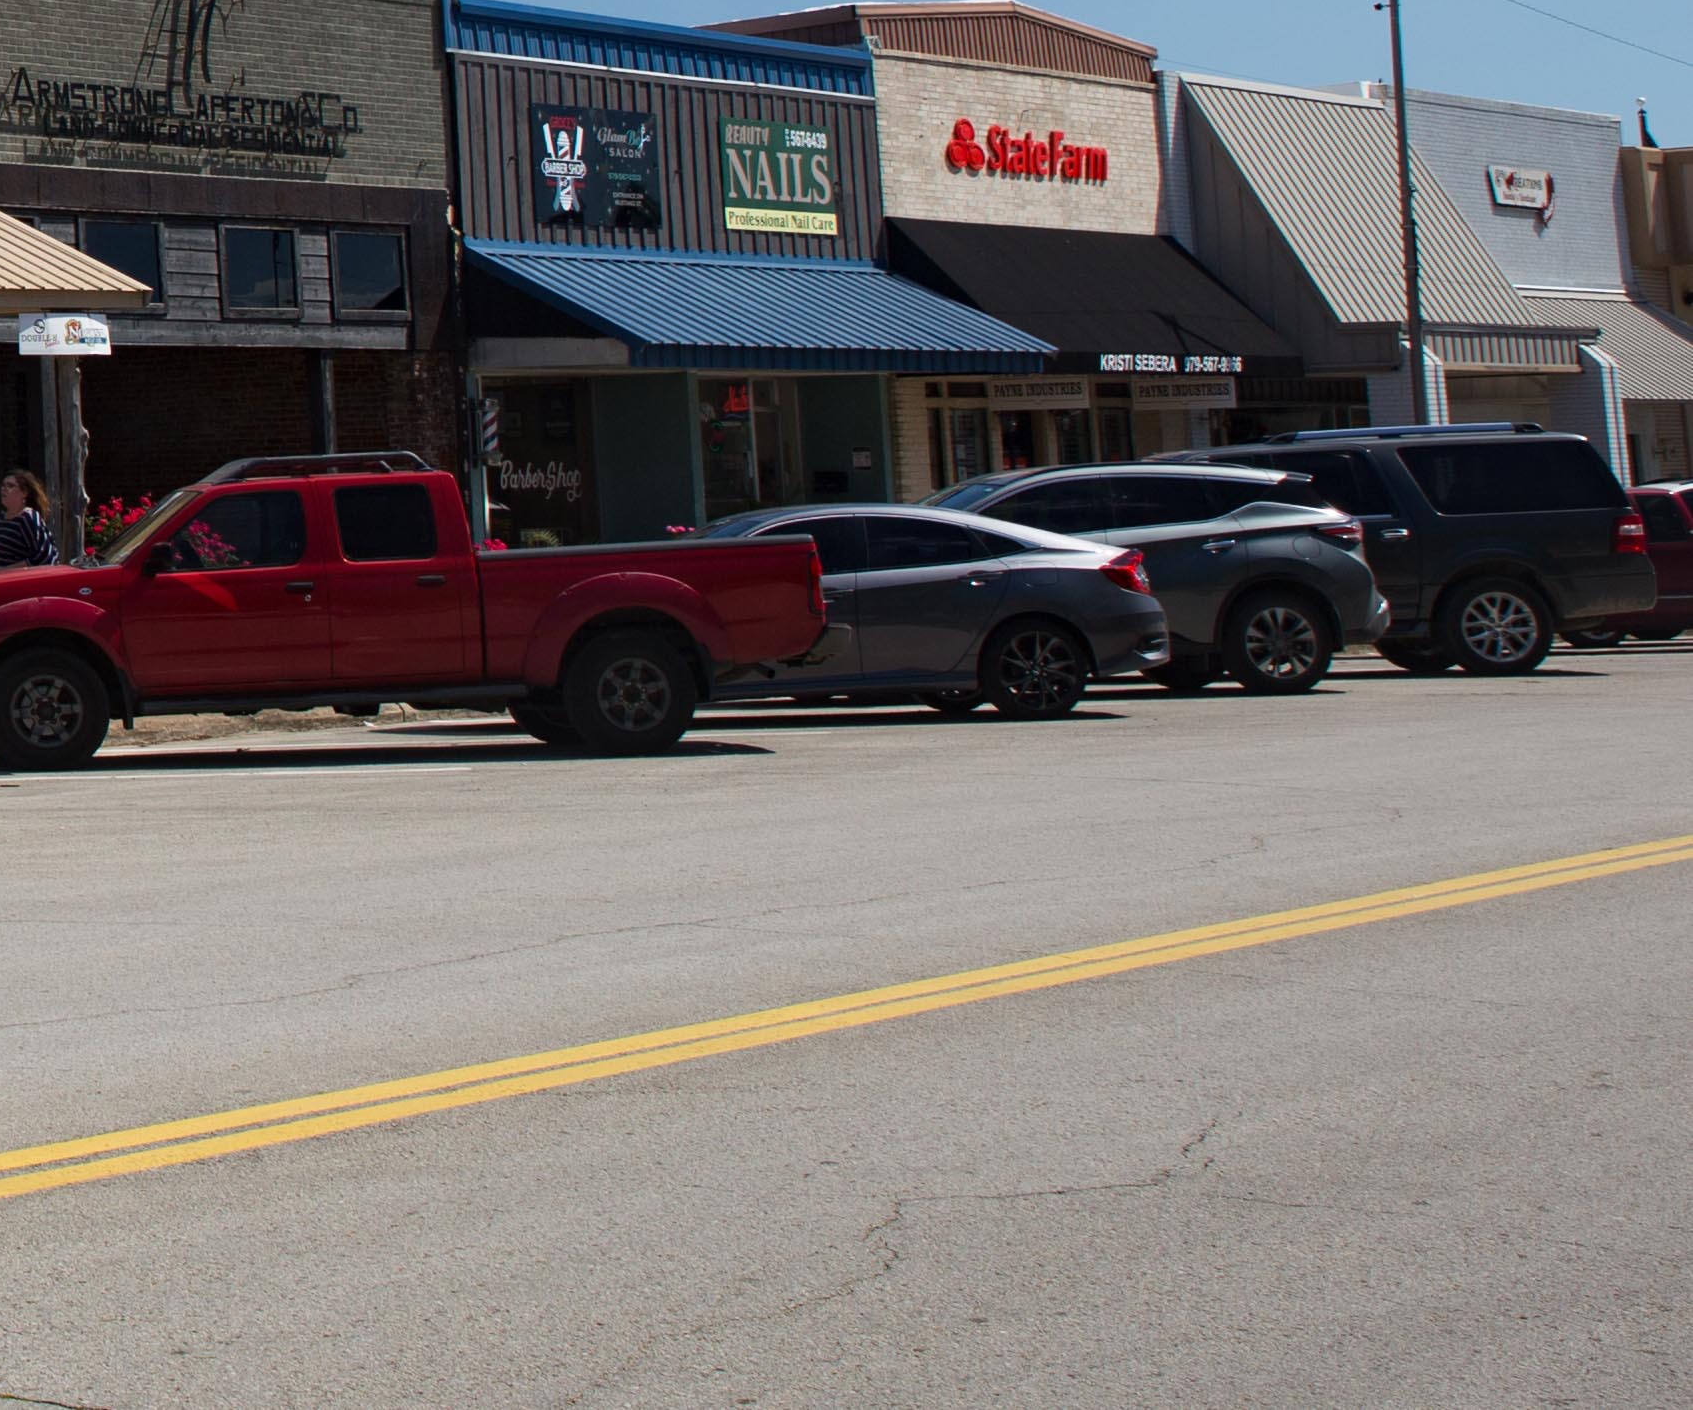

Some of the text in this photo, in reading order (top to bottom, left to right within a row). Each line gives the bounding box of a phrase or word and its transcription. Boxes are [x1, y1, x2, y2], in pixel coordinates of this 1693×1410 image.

[725, 124, 770, 147] BEAUTY
[609, 147, 642, 159] SALON
[725, 148, 832, 205] NAILS
[728, 211, 834, 231] Professional Nail Care
[1099, 353, 1134, 372] KRISTI
[1134, 354, 1178, 373] SEBERA
[993, 380, 1083, 398] PAYNE INDUSTRIES
[1138, 382, 1231, 398] PAYNE INDUSTRIES
